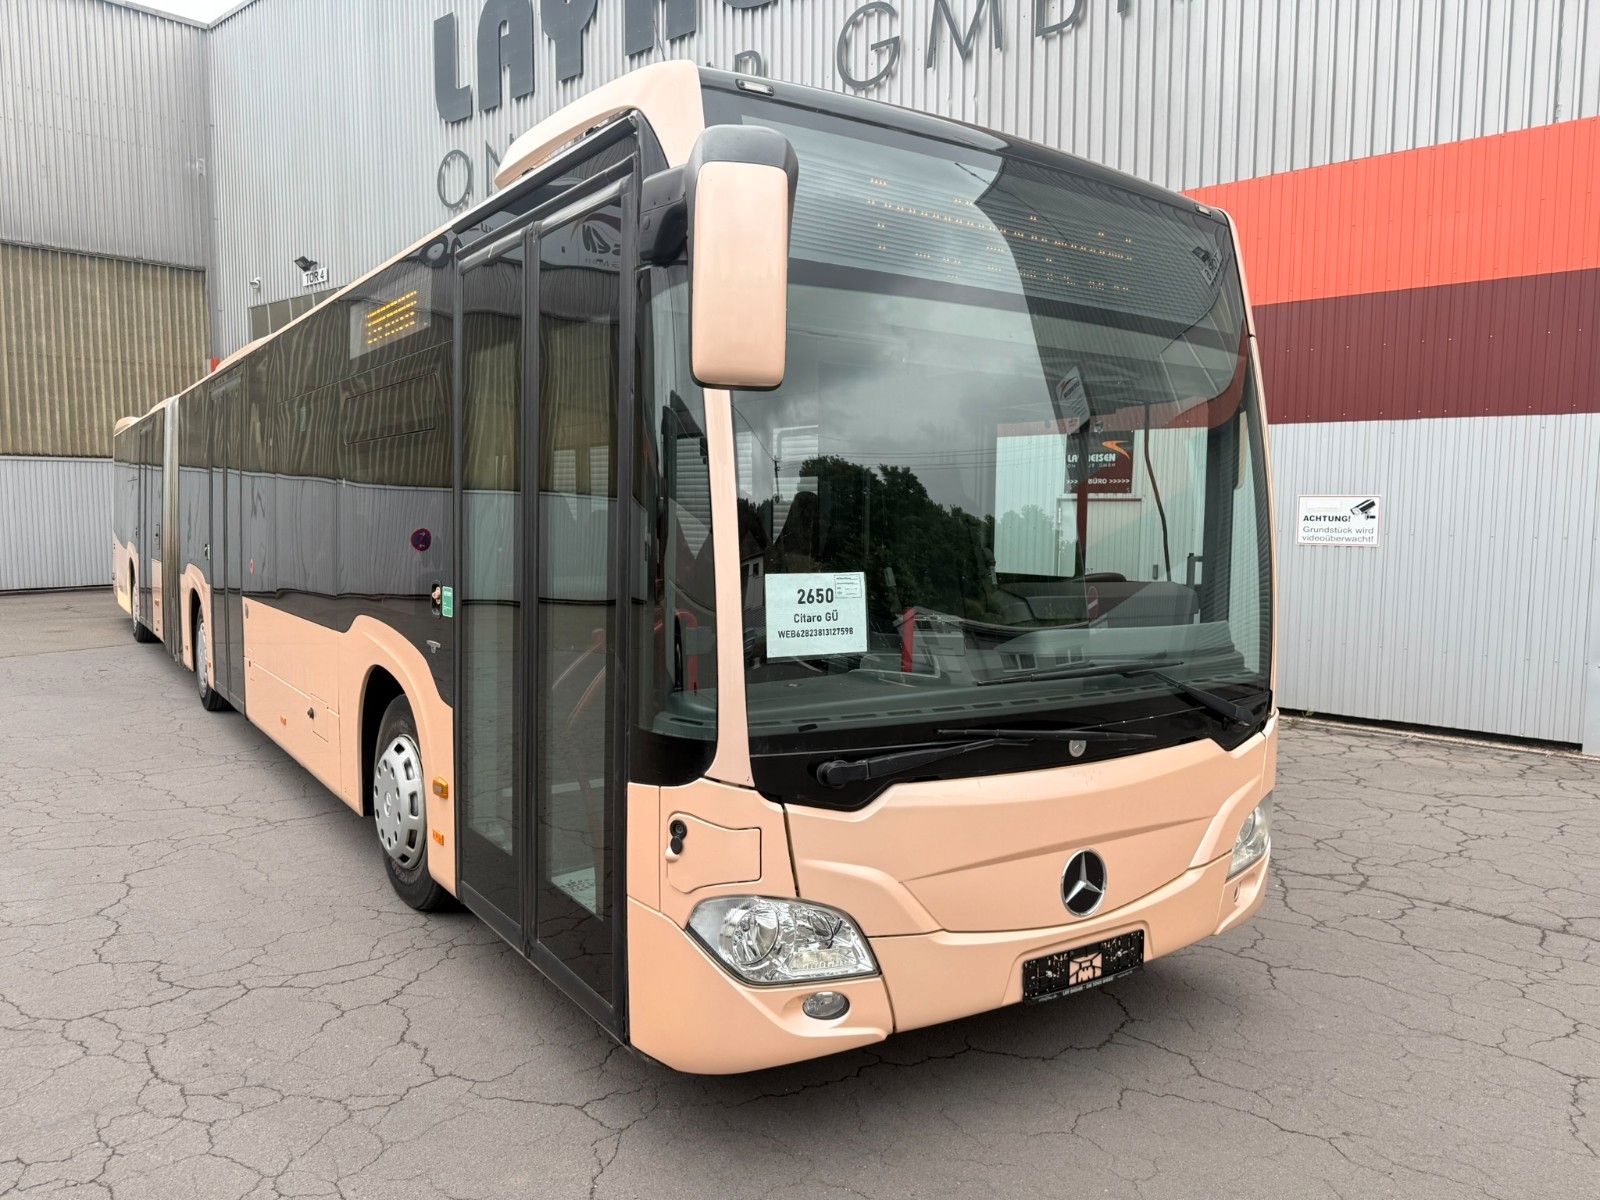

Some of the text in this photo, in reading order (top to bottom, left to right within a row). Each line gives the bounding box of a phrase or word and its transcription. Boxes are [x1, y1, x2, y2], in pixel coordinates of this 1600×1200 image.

[305, 269, 325, 285] TOR 4
[1302, 525, 1374, 534] Grundstück wird
[1302, 534, 1374, 543] videoüberwacht!
[797, 588, 834, 604] 2650
[793, 609, 838, 623] Citaro GÜ
